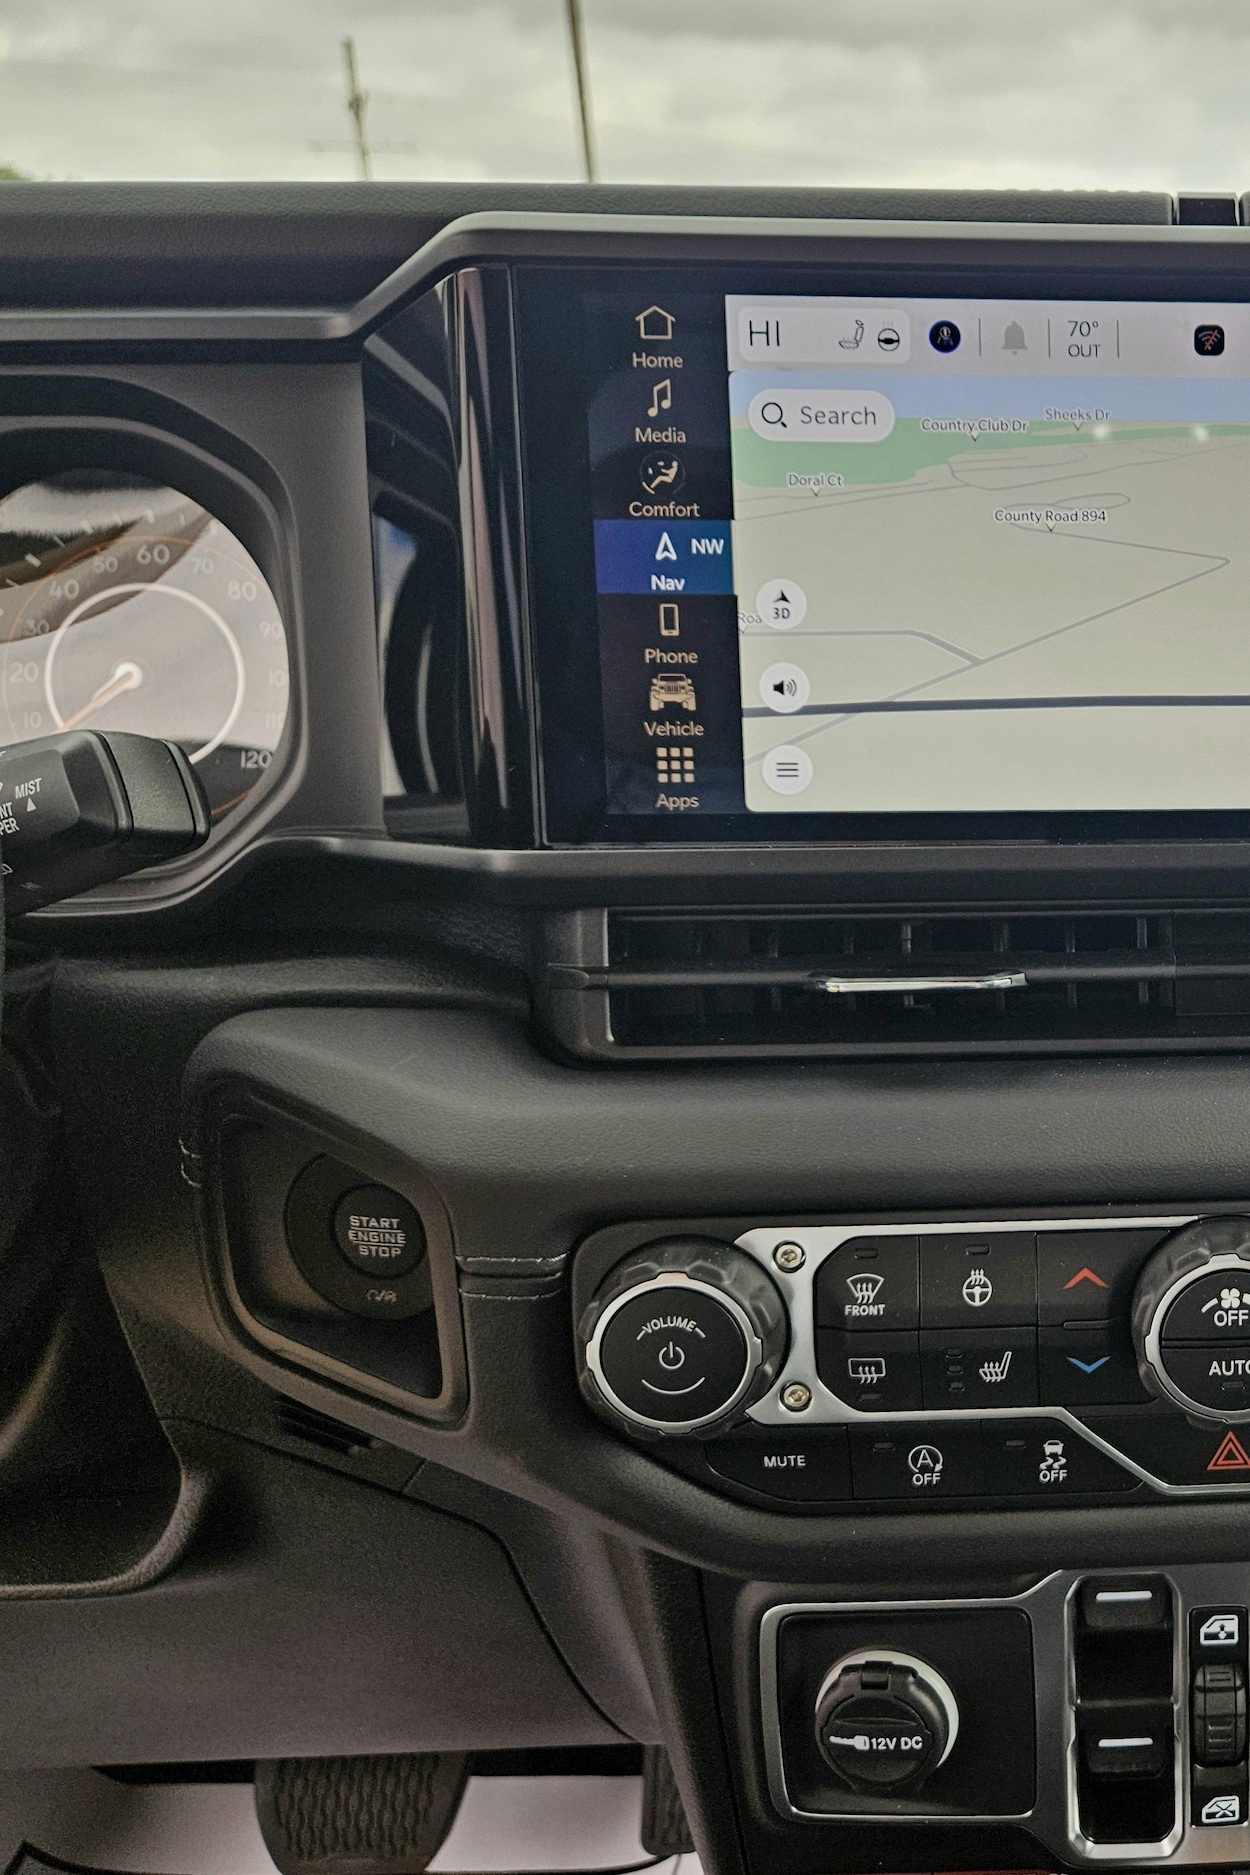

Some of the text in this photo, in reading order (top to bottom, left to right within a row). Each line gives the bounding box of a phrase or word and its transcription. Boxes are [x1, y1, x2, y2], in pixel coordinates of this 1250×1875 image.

[748, 319, 782, 348] HI
[1067, 320, 1100, 338] 70°
[1067, 343, 1101, 358] OUT
[632, 352, 684, 369] Home
[800, 405, 877, 426] Search
[1045, 408, 1110, 421] Sheeks Dr
[921, 418, 1028, 433] Country Club Dr
[634, 427, 687, 444] Media
[788, 474, 843, 487] Doral Ct
[628, 501, 701, 519] Comfort
[995, 510, 1106, 524] County Road 894
[136, 543, 170, 565] 60
[690, 538, 725, 555] NW
[93, 556, 119, 574] 50
[191, 557, 215, 575] 70
[49, 578, 80, 600] 40
[227, 580, 258, 601] 80
[650, 575, 686, 592] Nav
[737, 612, 763, 624] Roa
[772, 607, 791, 620] 3D
[24, 618, 50, 636] 30
[259, 620, 282, 638] 90
[644, 648, 699, 665] Phone
[9, 661, 40, 683] 20
[24, 711, 42, 729] 10
[643, 720, 705, 738] Vehicle
[239, 750, 273, 770] 120
[15, 777, 42, 799] MIST
[655, 793, 700, 811] Apps
[350, 1215, 400, 1229] START
[348, 1229, 406, 1244] ENGINE
[359, 1245, 402, 1258] STOP
[844, 1303, 886, 1318] FRONT
[1213, 1310, 1249, 1327] OFF
[644, 1316, 698, 1333] VOLUME
[763, 1454, 806, 1469] MUTE
[912, 1471, 941, 1486] OFF
[1038, 1468, 1068, 1484] OFF
[869, 1735, 923, 1750] 12V DC
